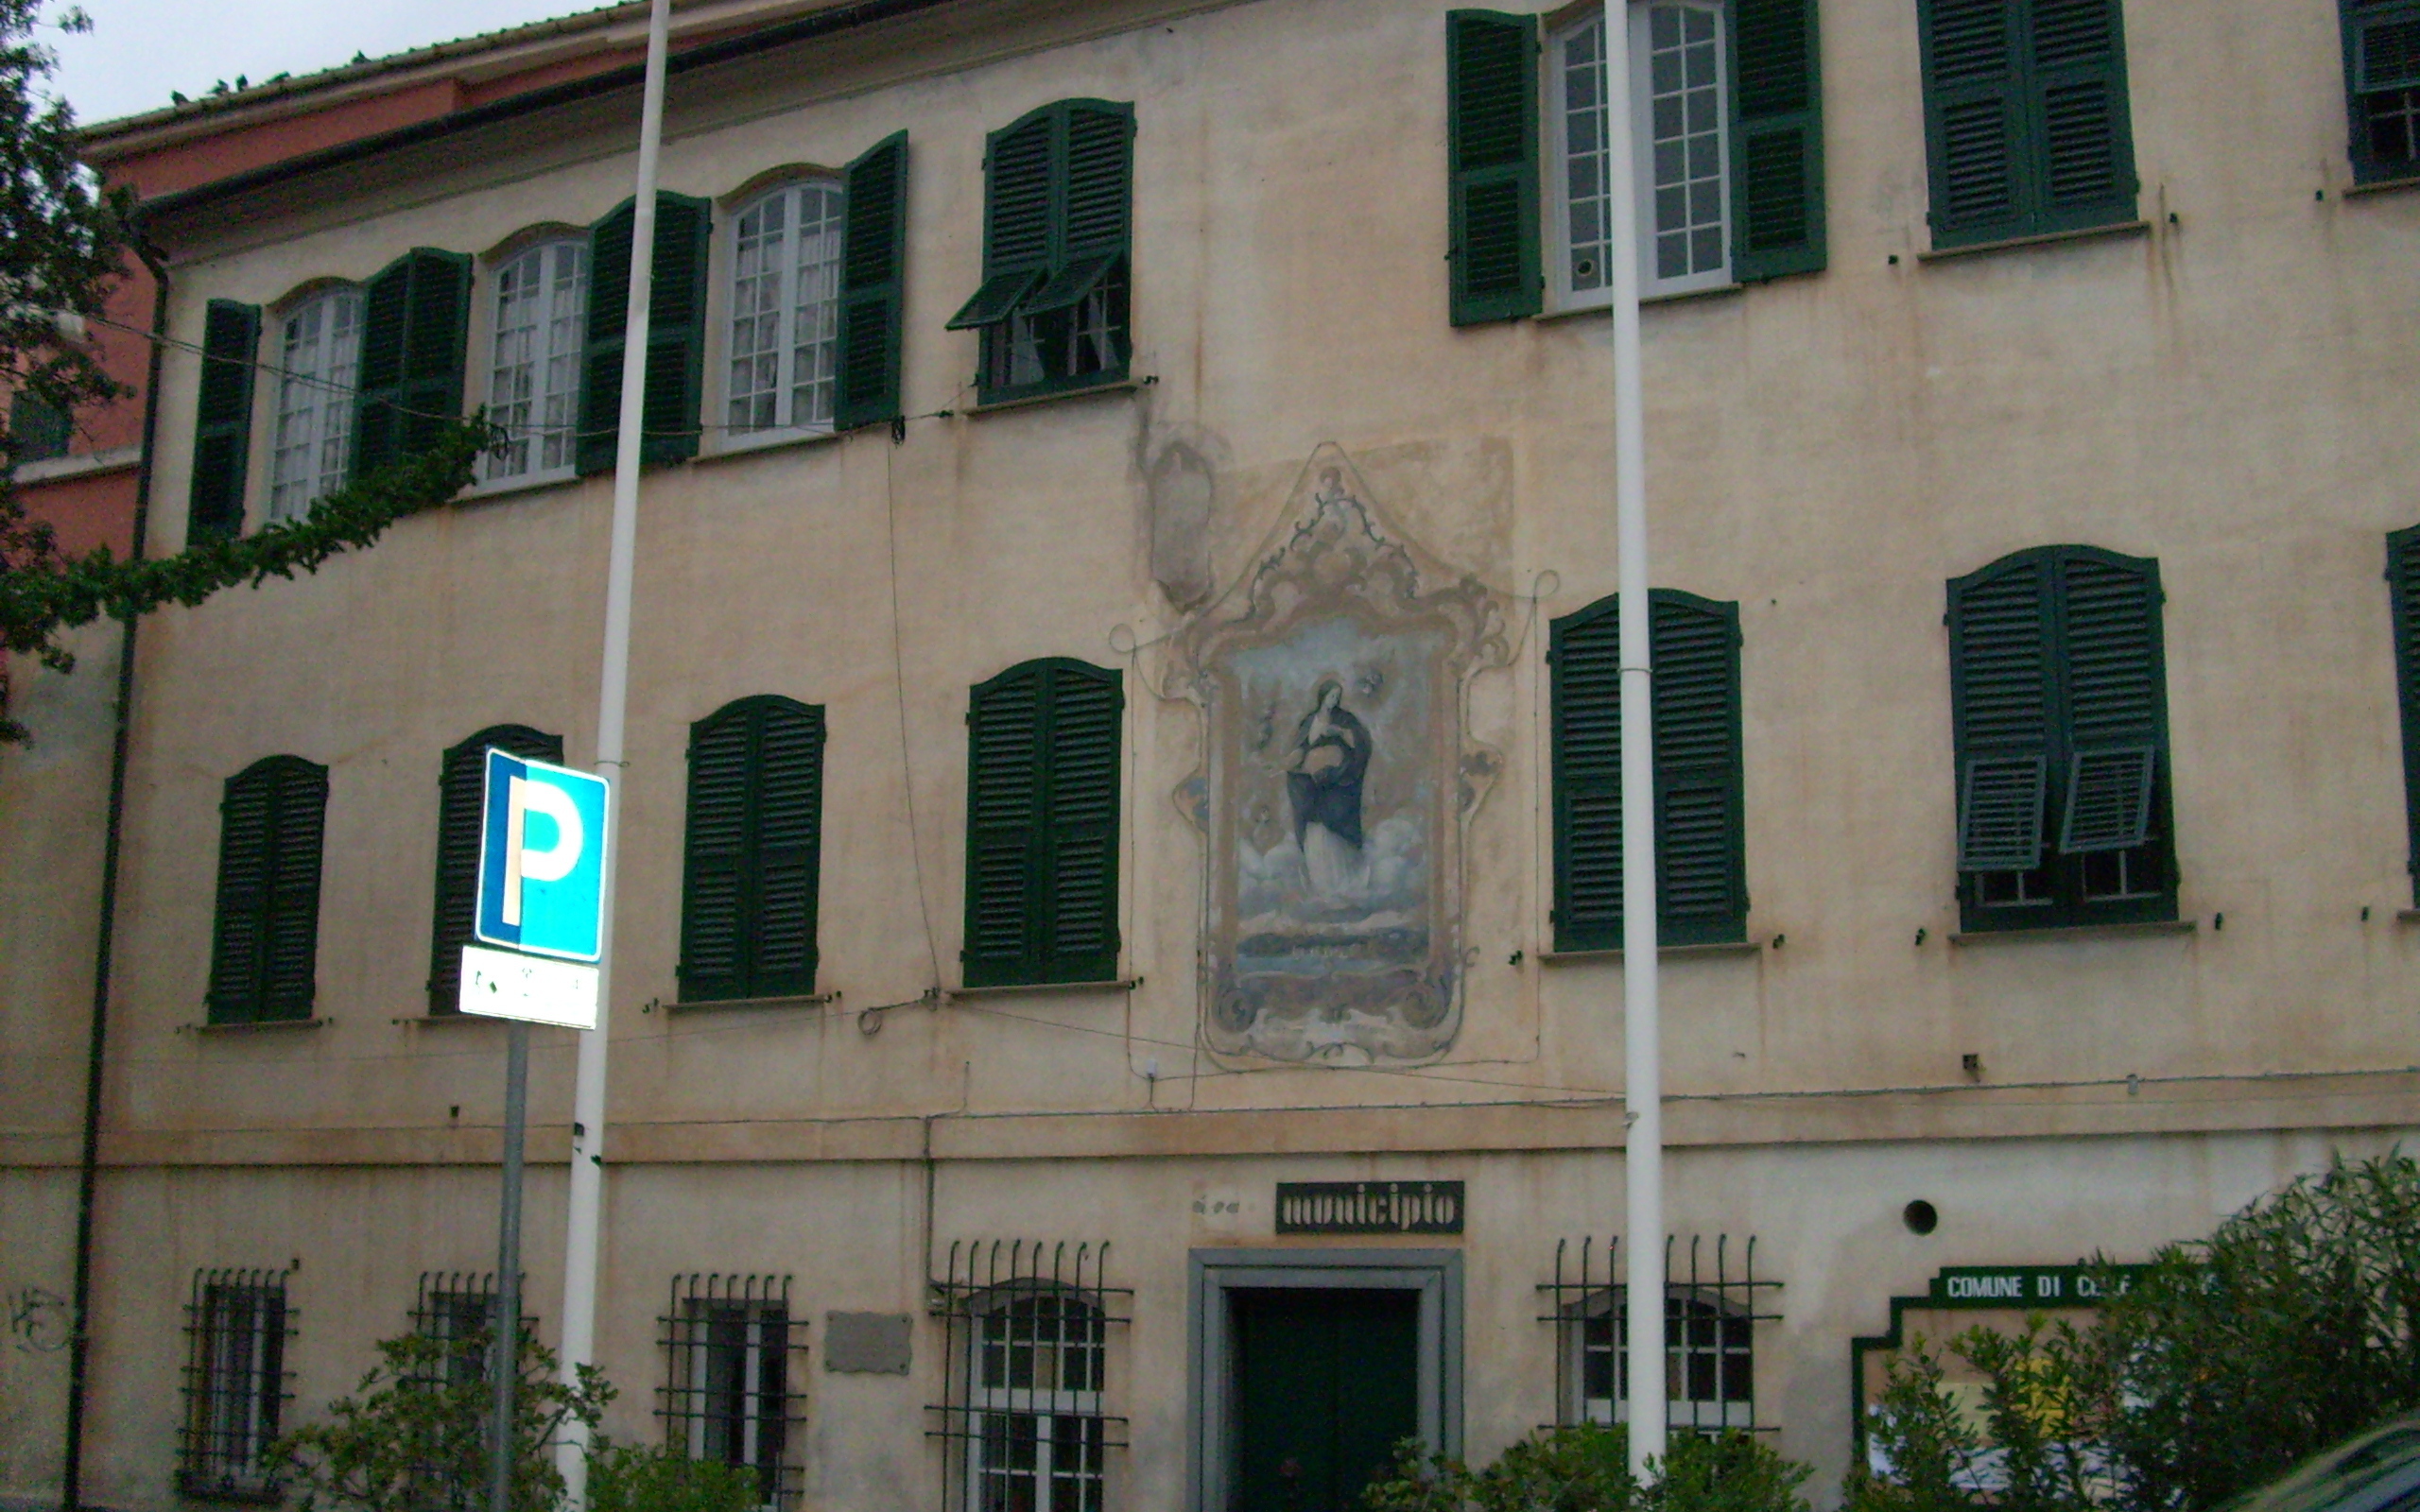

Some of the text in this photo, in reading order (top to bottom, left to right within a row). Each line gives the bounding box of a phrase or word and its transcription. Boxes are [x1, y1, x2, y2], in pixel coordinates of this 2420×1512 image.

[502, 775, 583, 927] P
[1283, 1183, 1455, 1230] municipio
[1947, 1276, 2023, 1297] COMUNE
[2037, 1276, 2061, 1297] DI
